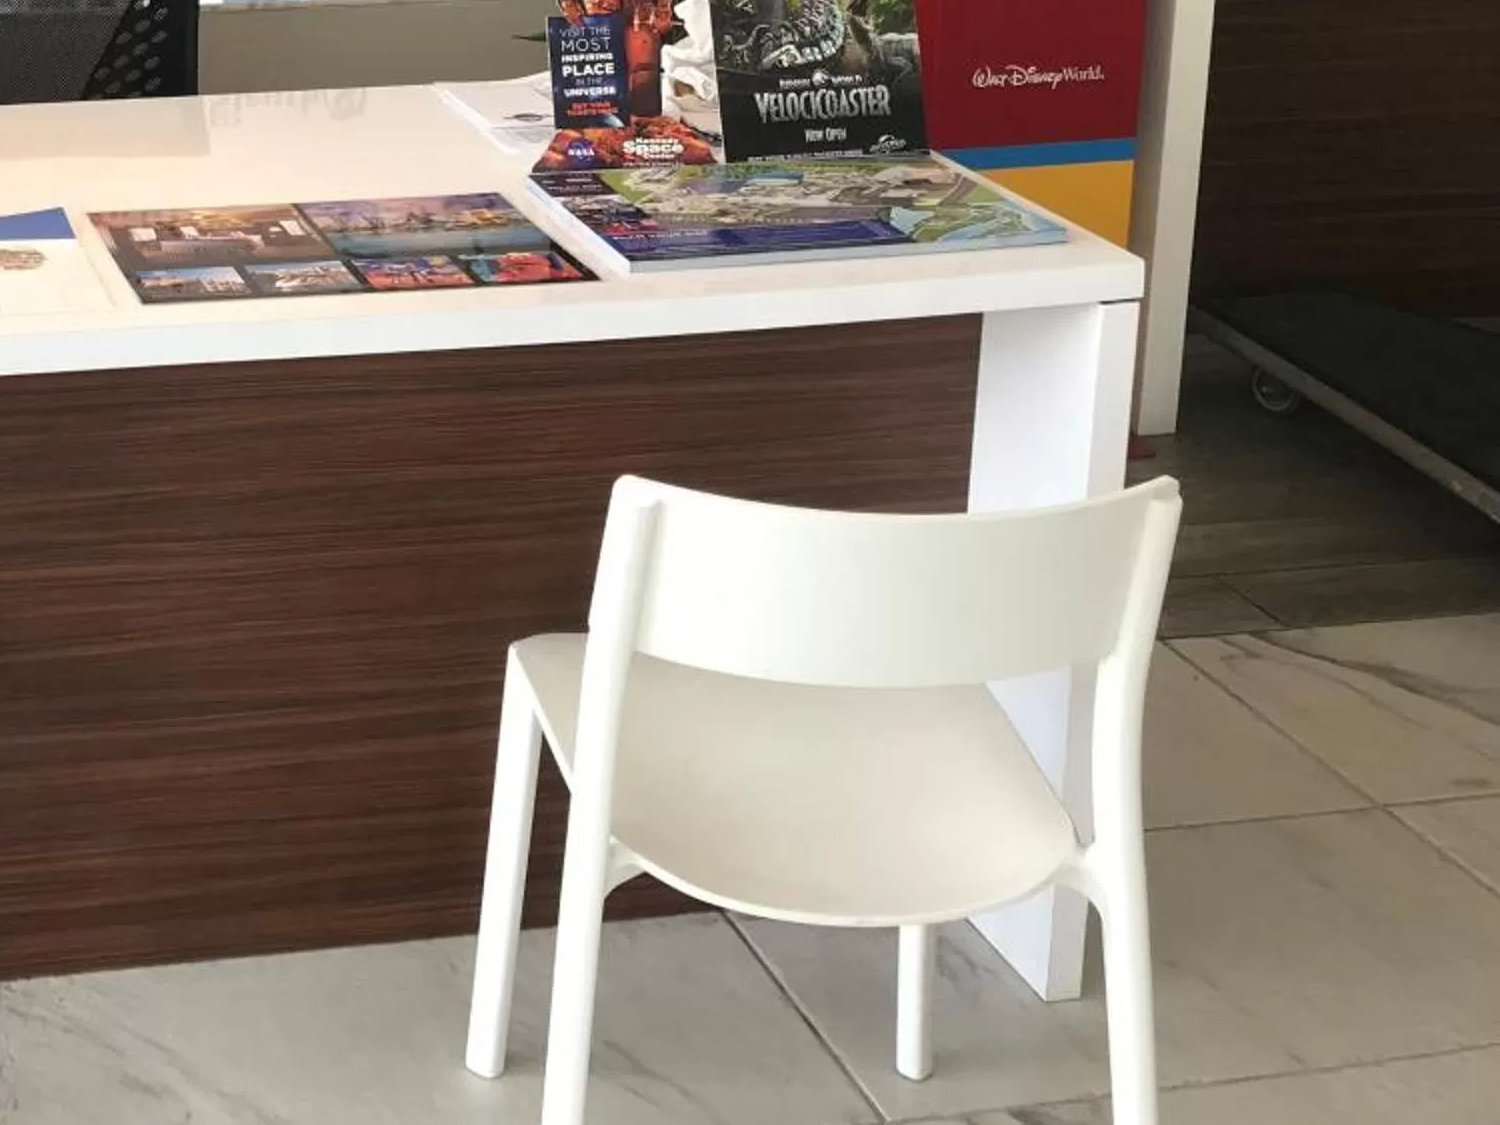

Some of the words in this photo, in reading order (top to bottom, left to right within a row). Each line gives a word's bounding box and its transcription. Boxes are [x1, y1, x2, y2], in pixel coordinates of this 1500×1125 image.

[561, 37, 611, 53] MOST
[562, 63, 615, 78] PLACE
[754, 84, 892, 124] VELOCICOASTER
[622, 140, 684, 156] Space
